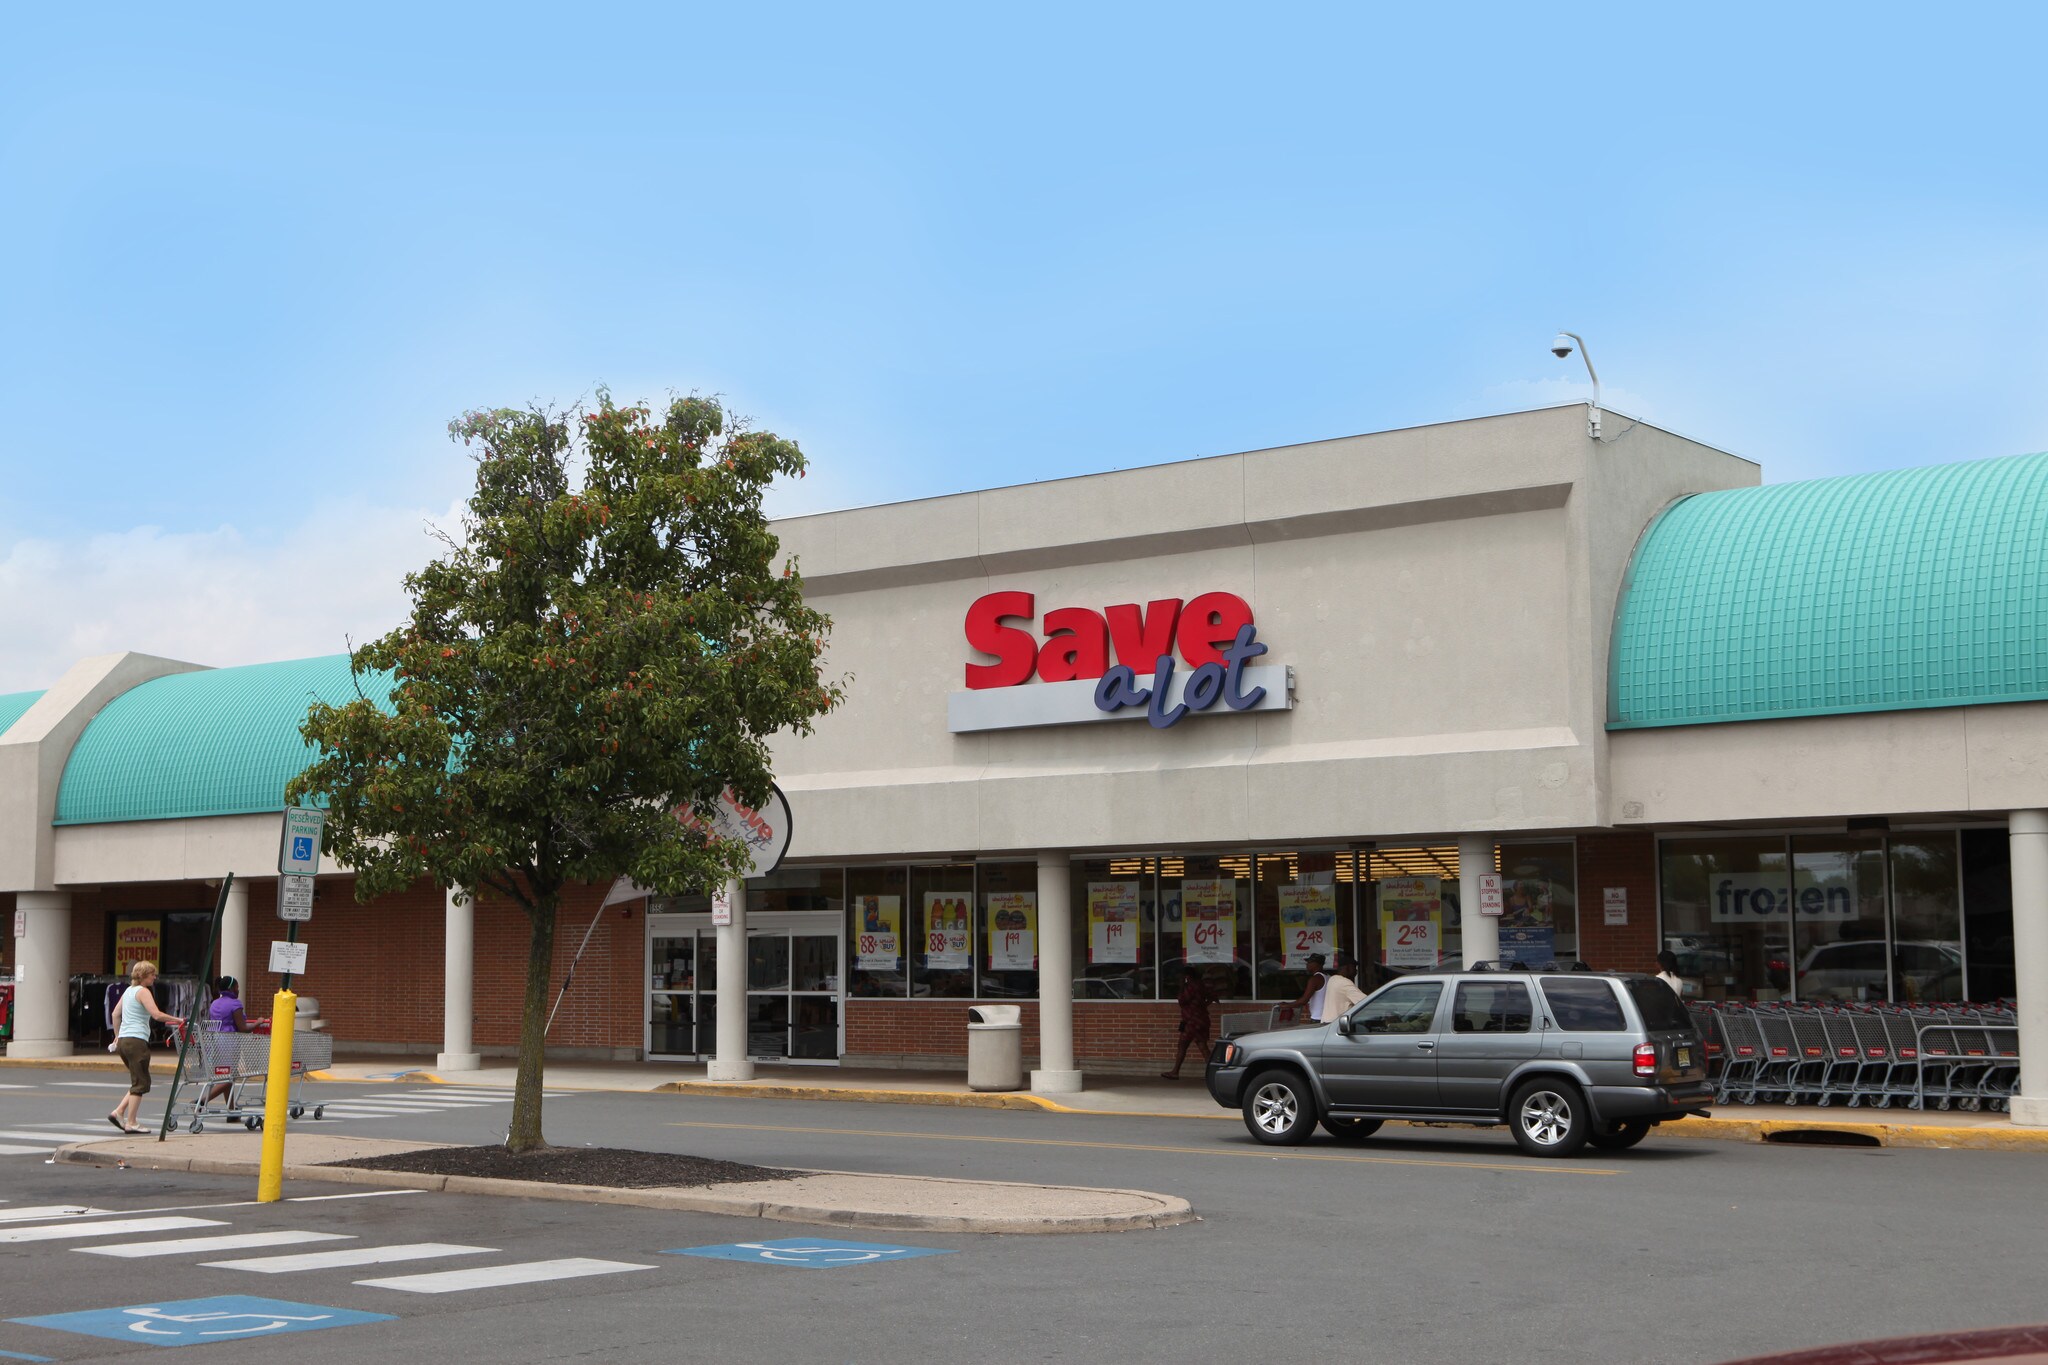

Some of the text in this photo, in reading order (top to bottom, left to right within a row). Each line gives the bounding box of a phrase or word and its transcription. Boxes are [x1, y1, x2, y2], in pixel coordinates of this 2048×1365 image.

[965, 591, 1254, 690] Save
[290, 813, 321, 825] RESERVED
[292, 825, 318, 835] PARKING
[1485, 879, 1495, 888] NO
[1716, 879, 1851, 915] frozen
[935, 920, 942, 929] G
[957, 920, 964, 929] G
[119, 927, 158, 940] FORMAN
[117, 946, 158, 961] STRETCH
